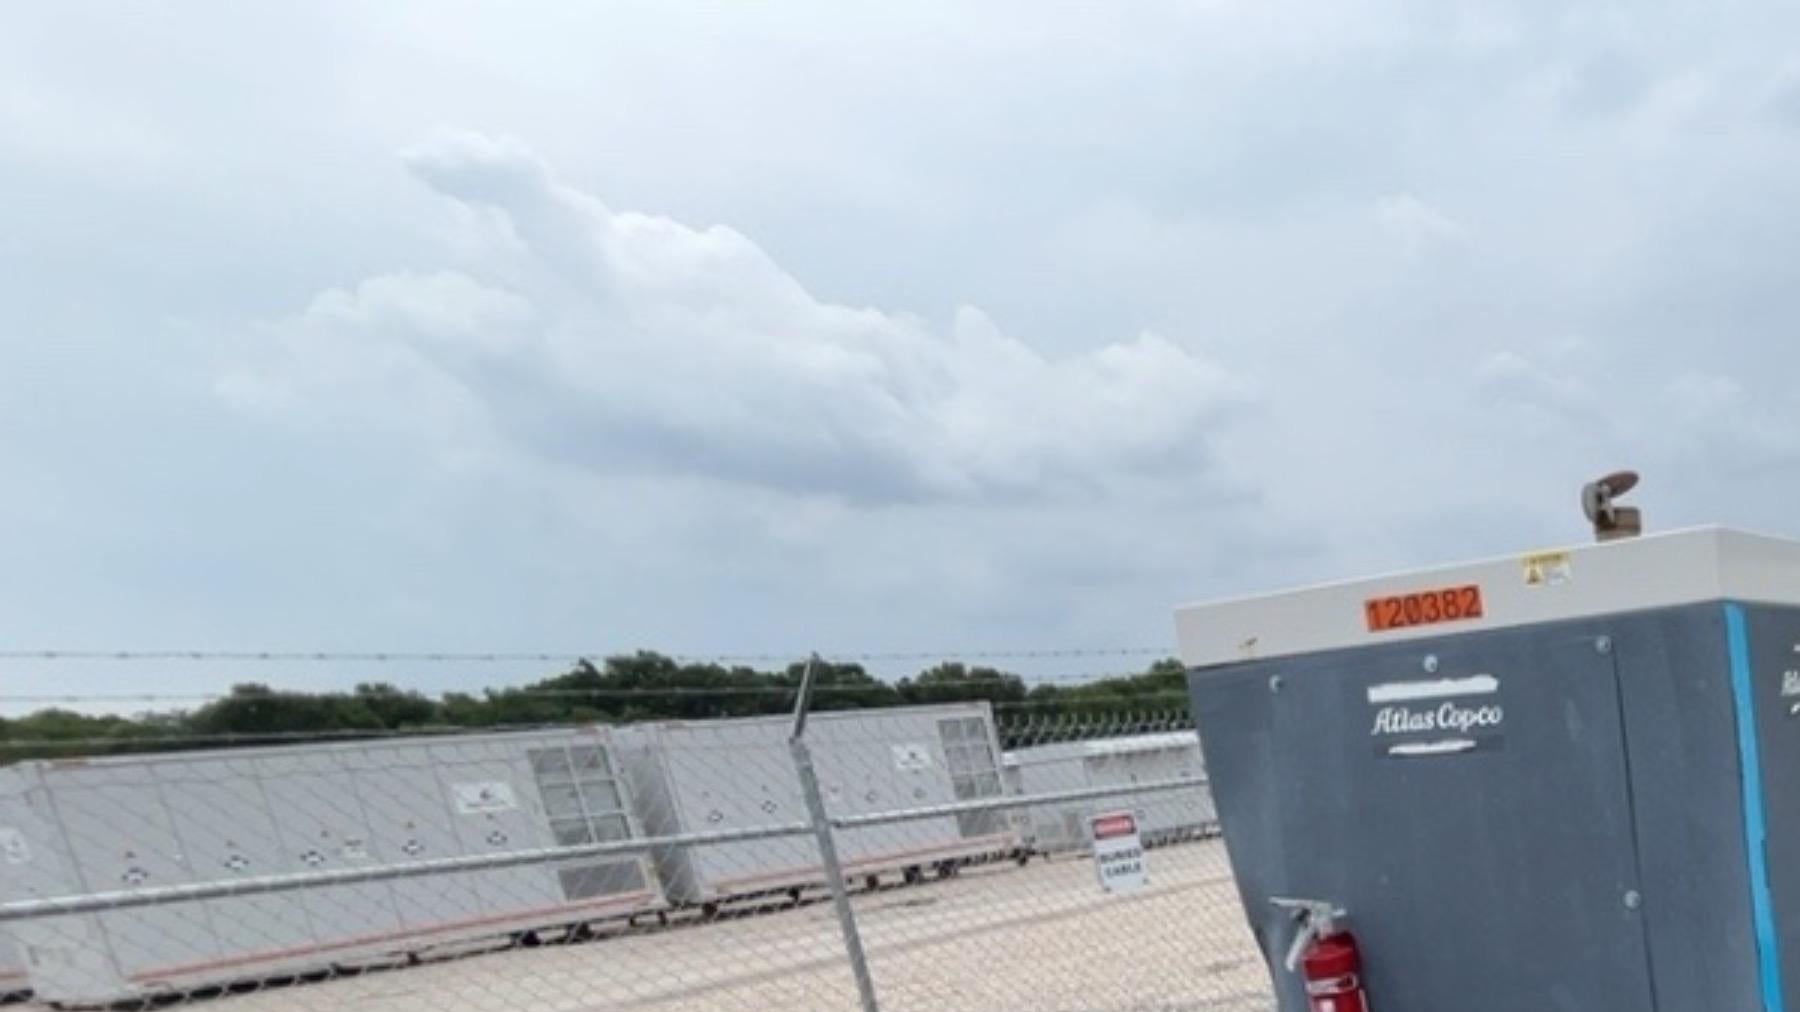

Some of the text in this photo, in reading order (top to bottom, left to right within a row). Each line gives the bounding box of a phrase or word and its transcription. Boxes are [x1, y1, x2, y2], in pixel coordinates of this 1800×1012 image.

[1367, 586, 1482, 630] 120382
[1371, 702, 1504, 735] Atlas Copco
